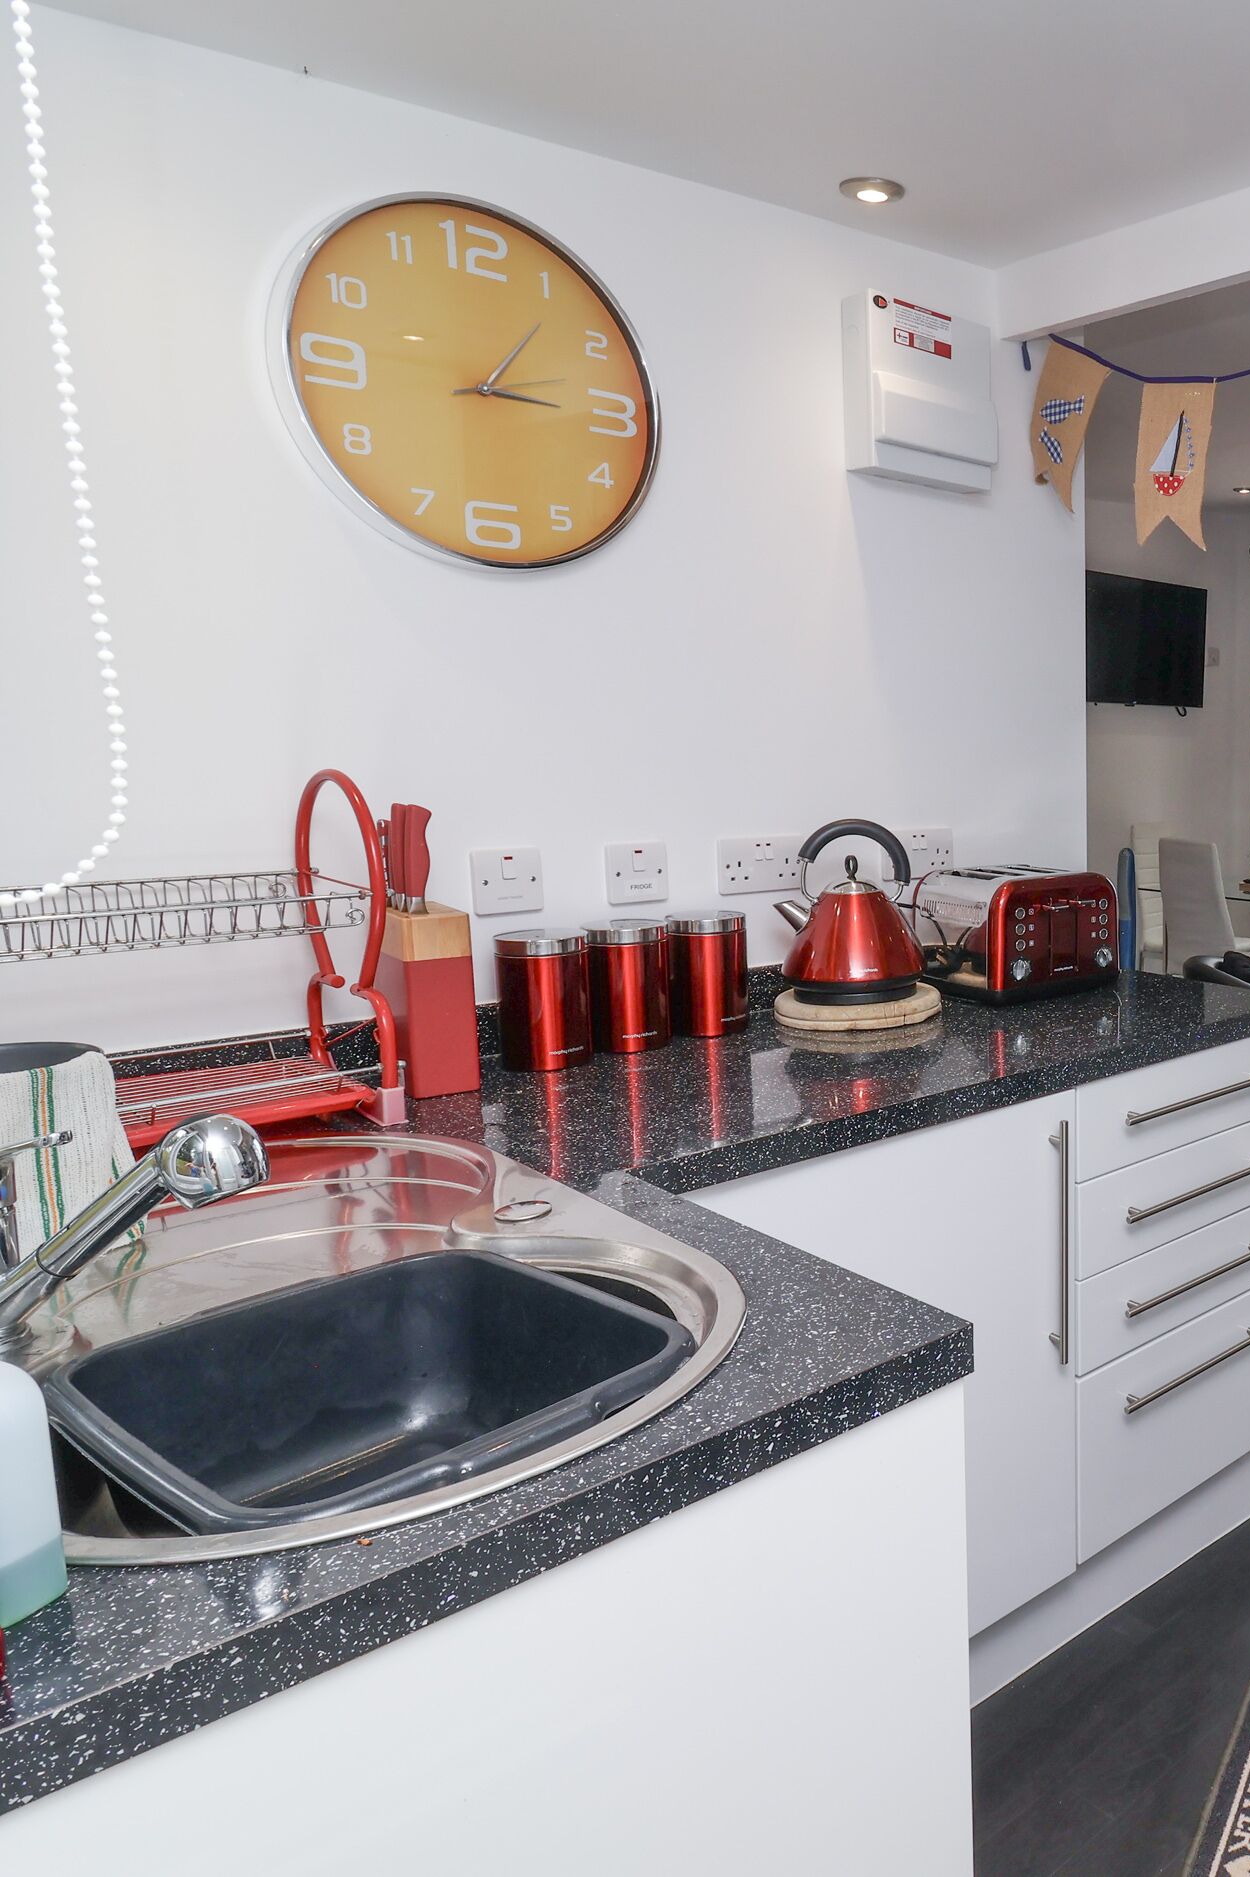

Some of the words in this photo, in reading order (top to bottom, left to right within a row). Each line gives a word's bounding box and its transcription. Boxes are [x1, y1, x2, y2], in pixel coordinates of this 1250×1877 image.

[386, 231, 414, 265] 11
[438, 219, 509, 283] 12
[325, 272, 368, 309] 10
[539, 271, 550, 299] 1
[300, 332, 367, 390] 9
[585, 330, 608, 360] 2
[587, 388, 638, 438] 3
[343, 424, 372, 455] 8
[587, 462, 615, 489] 4
[410, 488, 435, 516] 7
[549, 504, 573, 532] 5
[464, 500, 522, 551] 6
